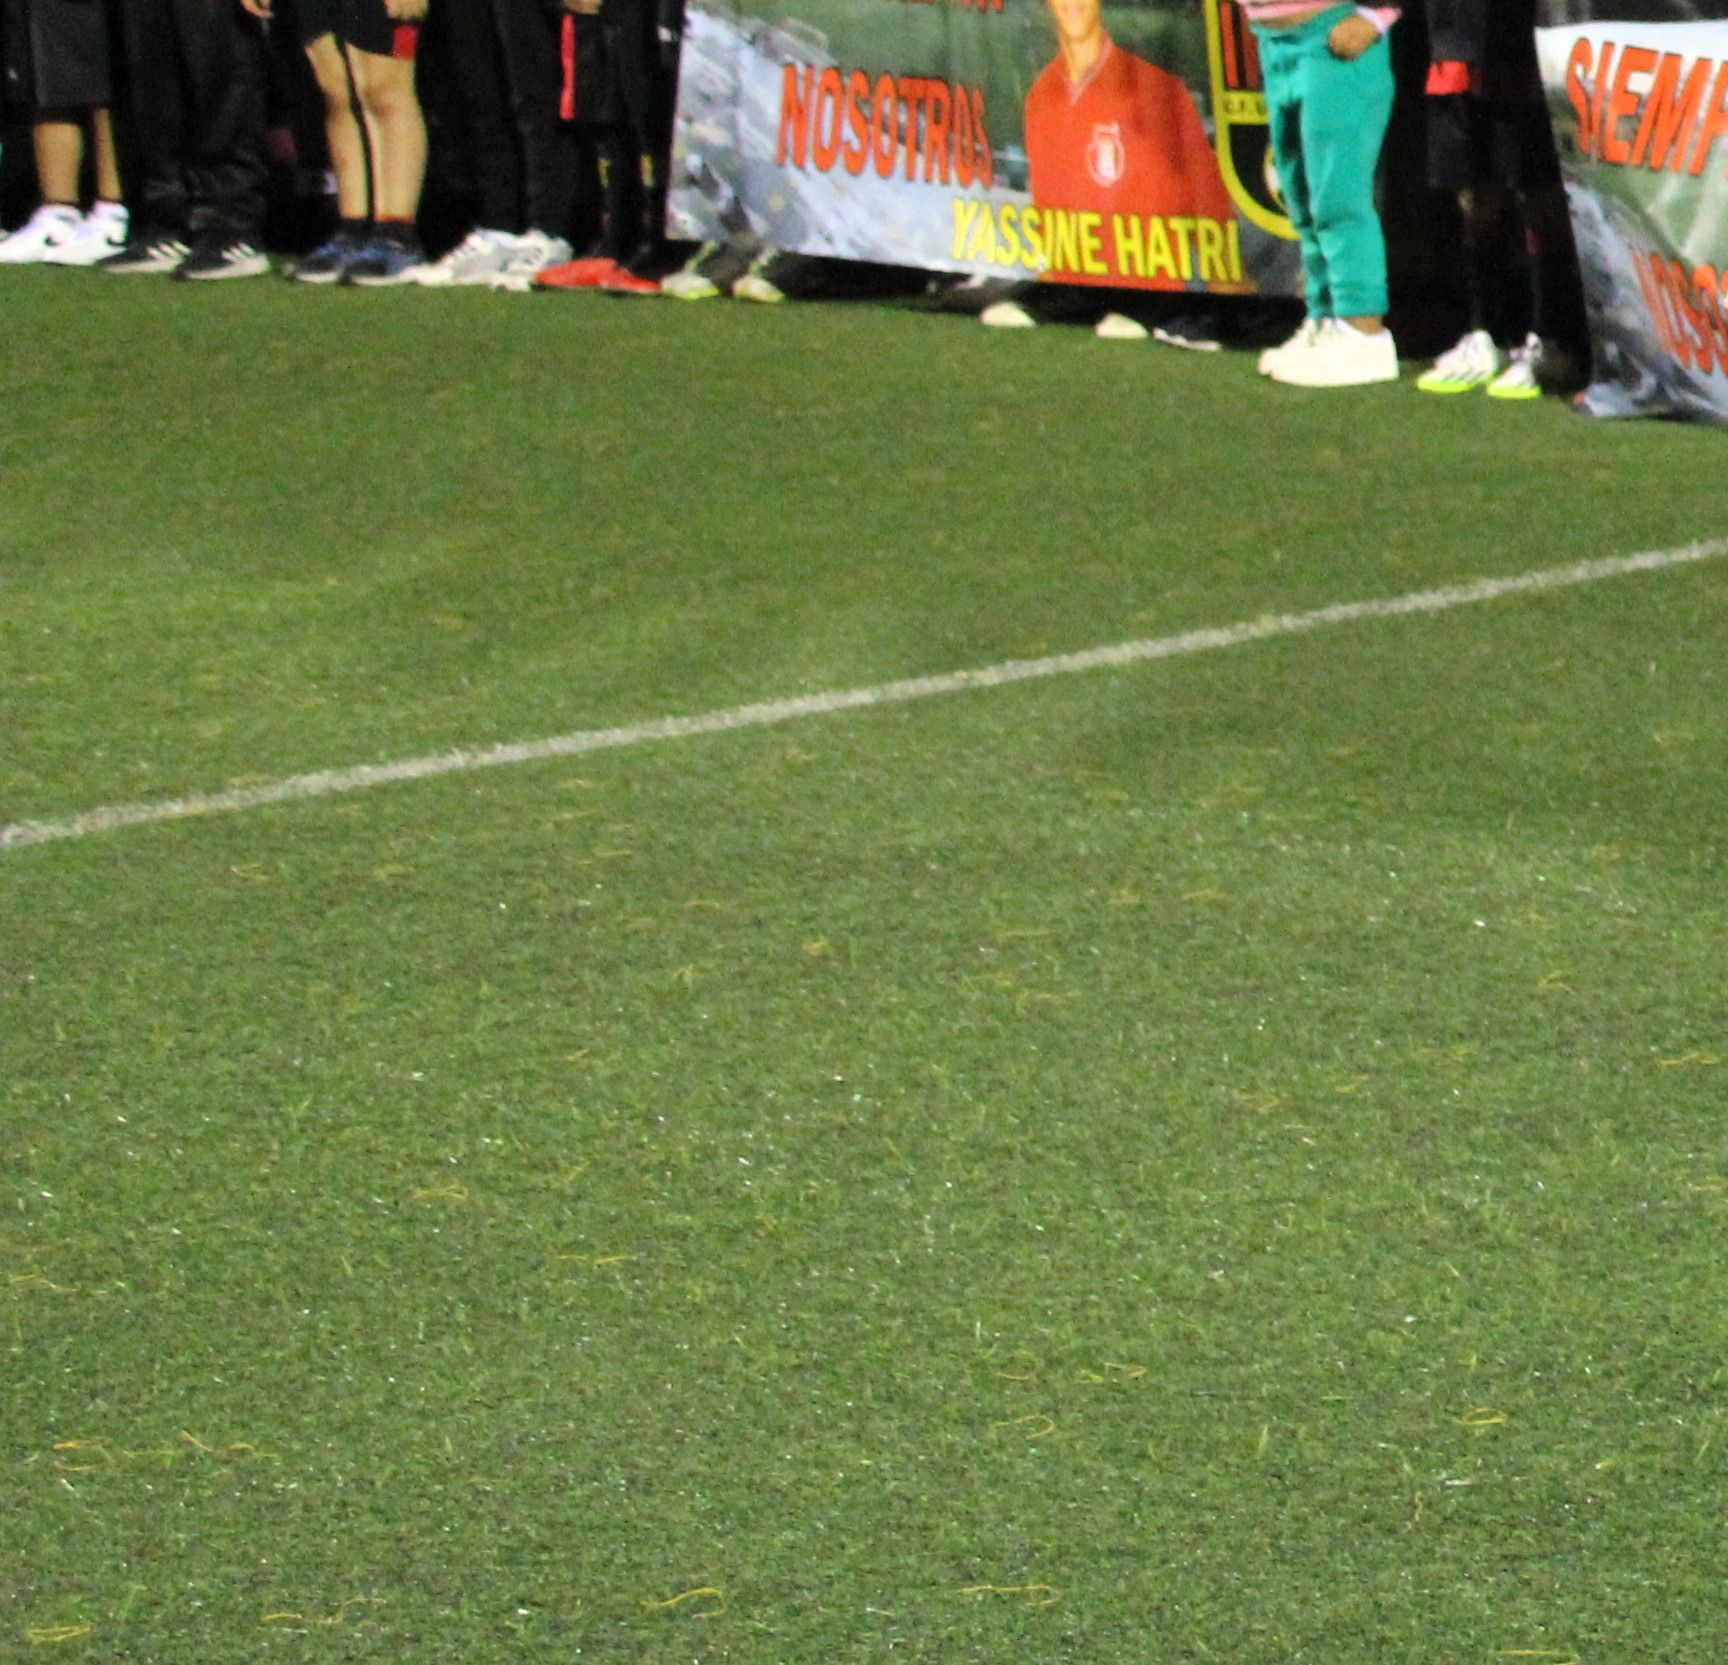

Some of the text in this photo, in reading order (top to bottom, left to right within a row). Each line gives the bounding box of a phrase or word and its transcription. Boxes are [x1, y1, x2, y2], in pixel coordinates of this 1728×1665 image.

[773, 62, 994, 192] NOSOTROS
[951, 197, 1243, 283] YASSINE HATRI
